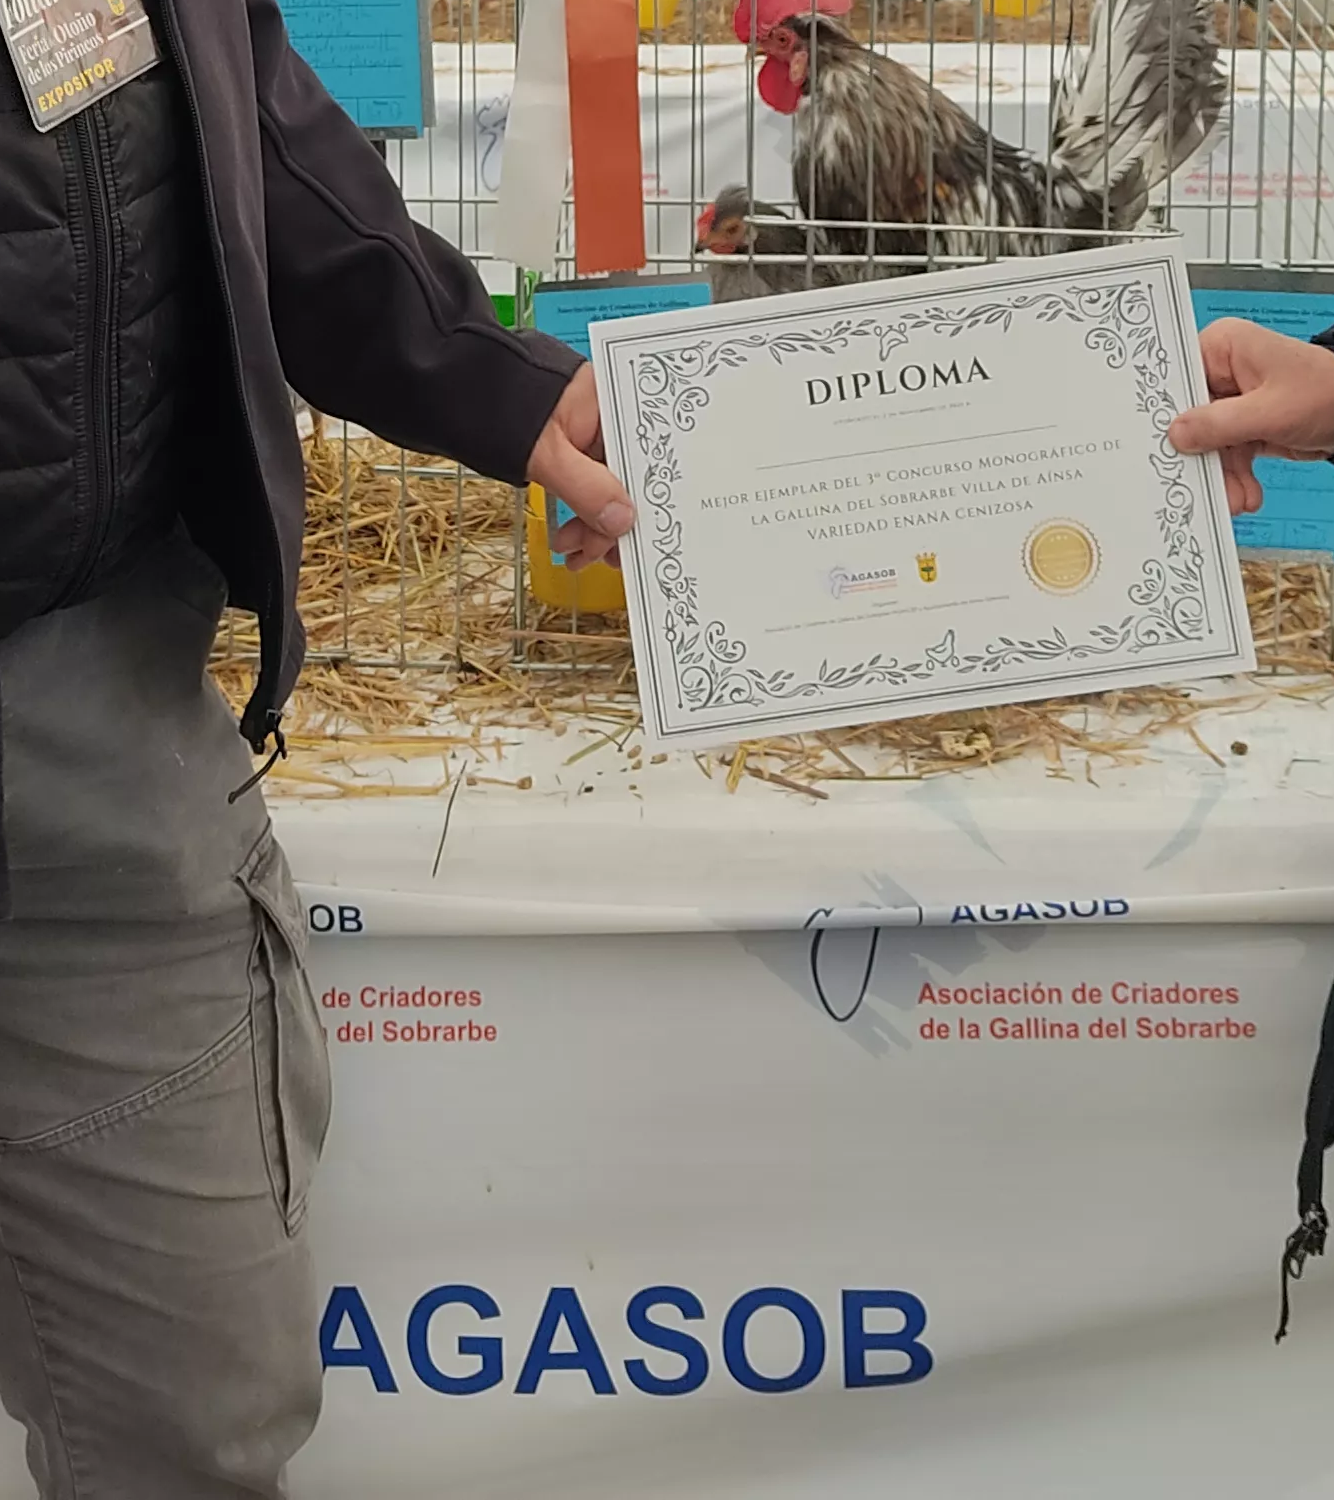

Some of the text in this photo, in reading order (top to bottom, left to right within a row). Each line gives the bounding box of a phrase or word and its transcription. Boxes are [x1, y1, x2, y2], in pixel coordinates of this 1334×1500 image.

[17, 35, 50, 66] Feria
[52, 11, 97, 44] Otoño
[27, 66, 43, 86] de
[42, 59, 59, 79] los
[54, 31, 105, 70] Pirineos
[37, 57, 117, 113] EXPOSITOR
[805, 356, 992, 406] DIPLOMA
[701, 493, 749, 510] MEJOR
[755, 481, 829, 503] EJEMPLAR
[833, 476, 861, 490] DEL
[751, 514, 770, 526] LA
[847, 497, 875, 512] DEL
[1011, 475, 1031, 488] DE
[807, 518, 888, 540] VARIEDAD
[894, 510, 950, 529] ENANA
[850, 567, 897, 583] AGASOB
[321, 985, 483, 1009] de Criadores
[917, 981, 1240, 1005] Asociación de Criadores
[336, 1020, 374, 1043] del
[382, 1019, 497, 1043] Sobrarbe
[919, 1016, 1257, 1040] de la Gallina del Sobrarbe
[317, 1283, 935, 1396] AGASOB
